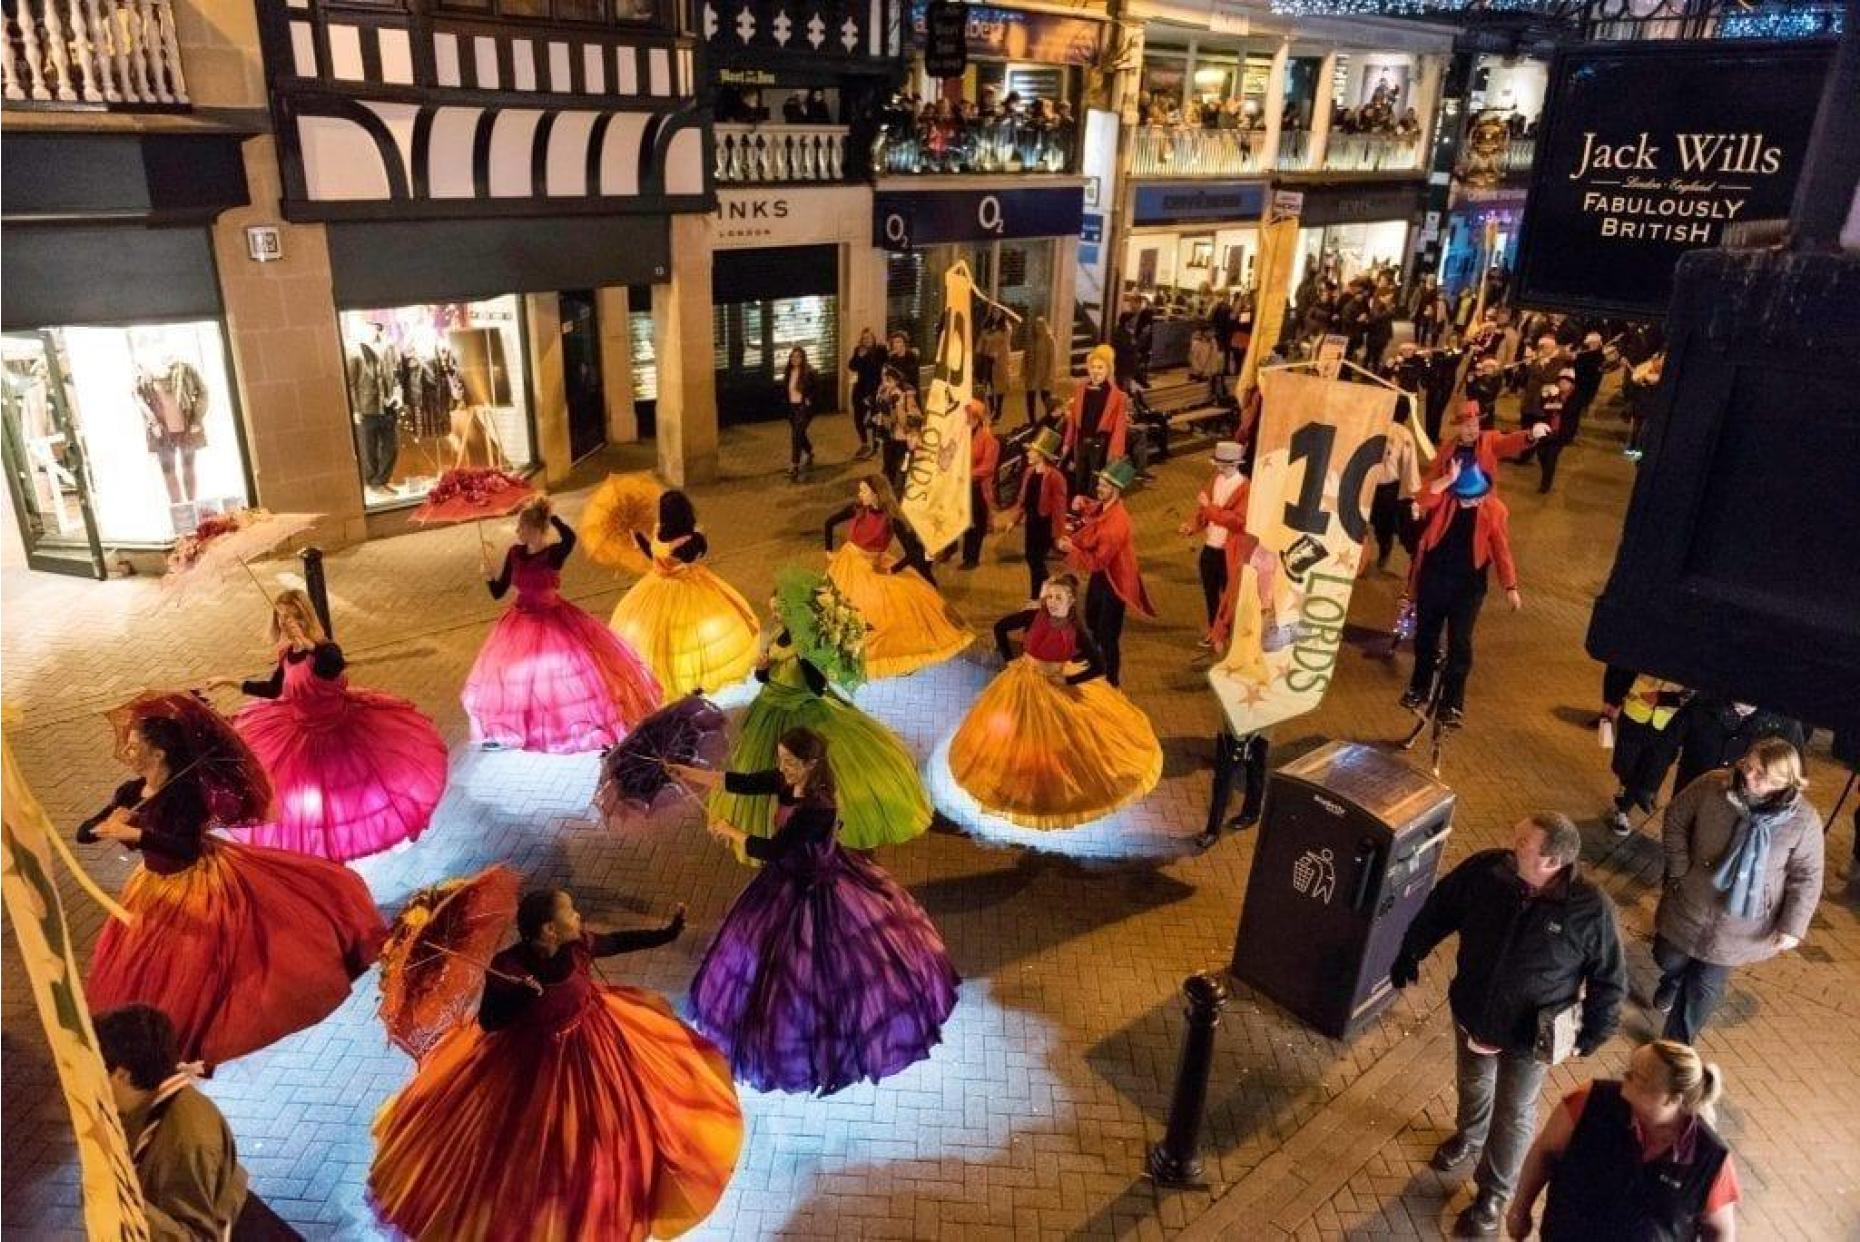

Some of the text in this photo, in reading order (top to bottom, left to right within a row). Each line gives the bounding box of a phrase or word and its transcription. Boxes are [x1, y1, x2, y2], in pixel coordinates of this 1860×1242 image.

[1569, 132, 1782, 179] Jack Wills
[717, 199, 788, 219] INKS
[1583, 192, 1745, 219] FABULOUSLY
[1601, 217, 1711, 242] BRITISH
[1286, 570, 1353, 694] LORDS
